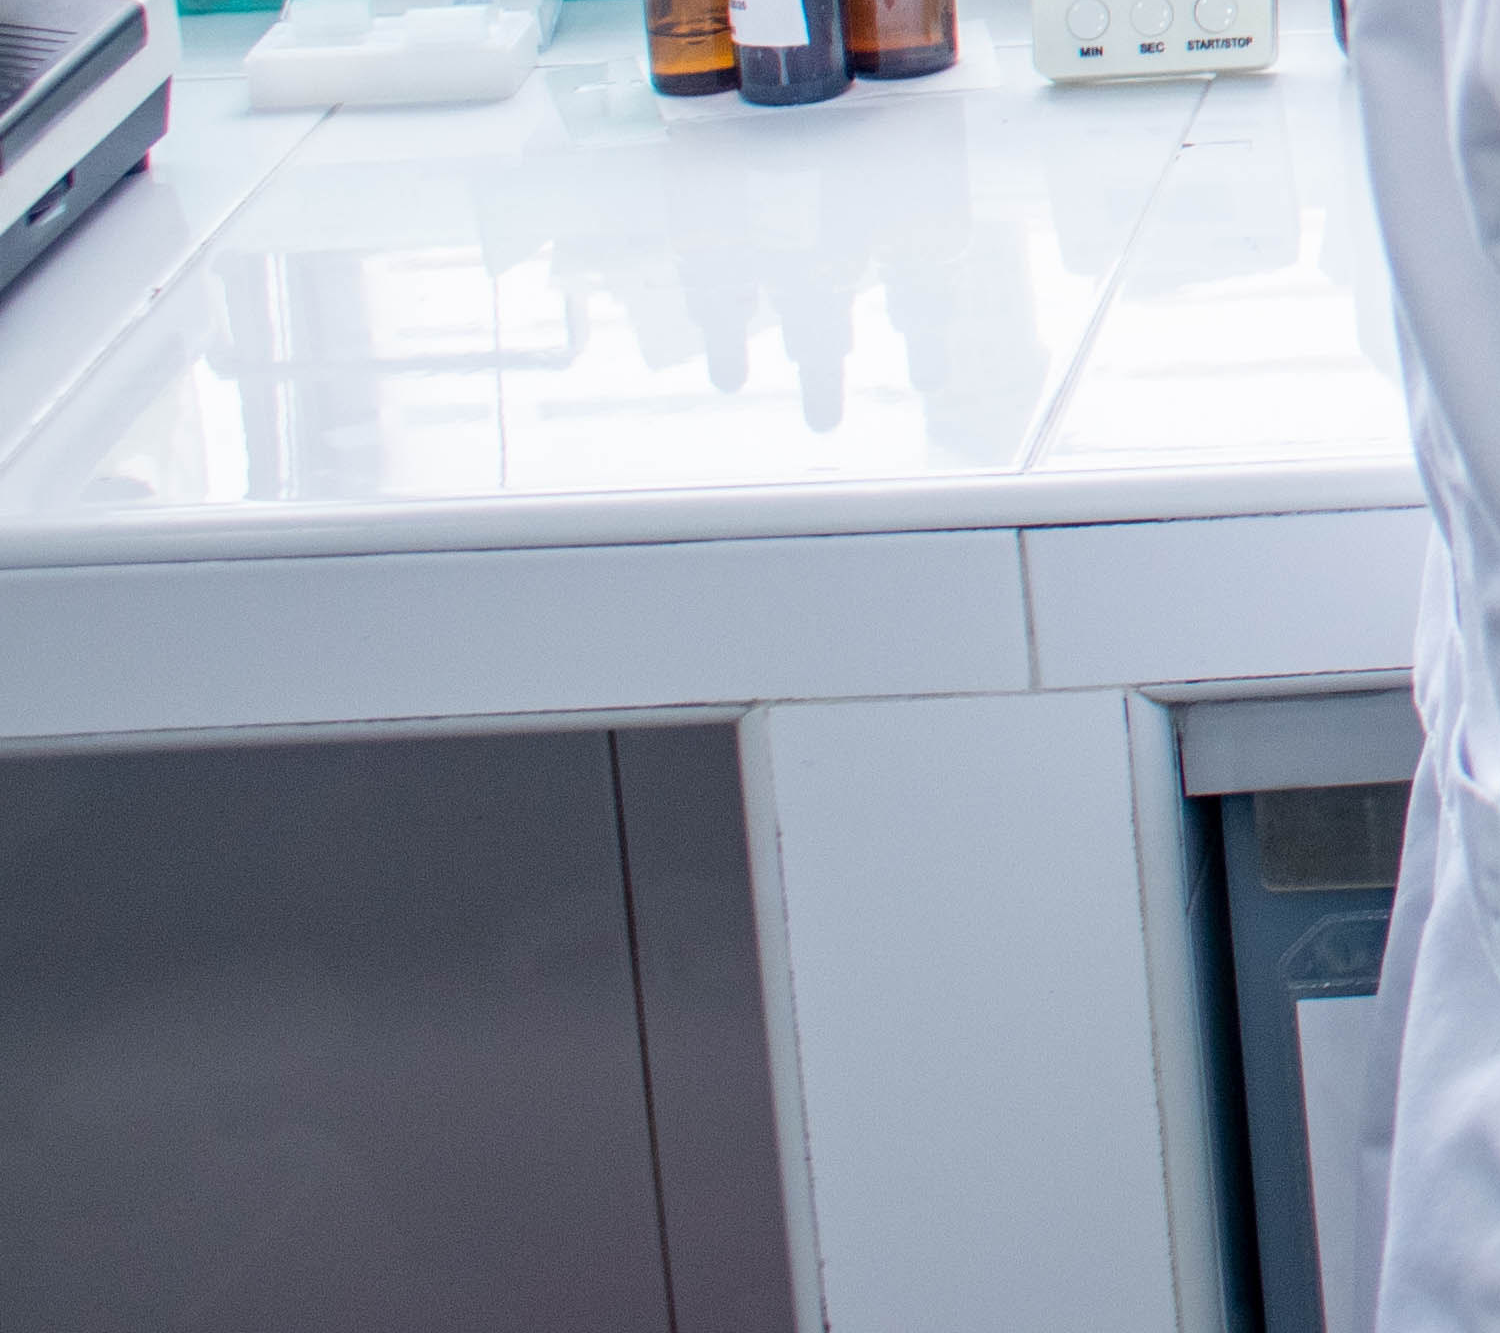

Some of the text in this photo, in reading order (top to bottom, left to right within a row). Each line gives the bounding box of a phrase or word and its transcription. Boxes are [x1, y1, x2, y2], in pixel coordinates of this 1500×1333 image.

[1140, 42, 1165, 54] SEC
[1187, 37, 1252, 50] START/STOP
[1080, 46, 1103, 57] MIN
